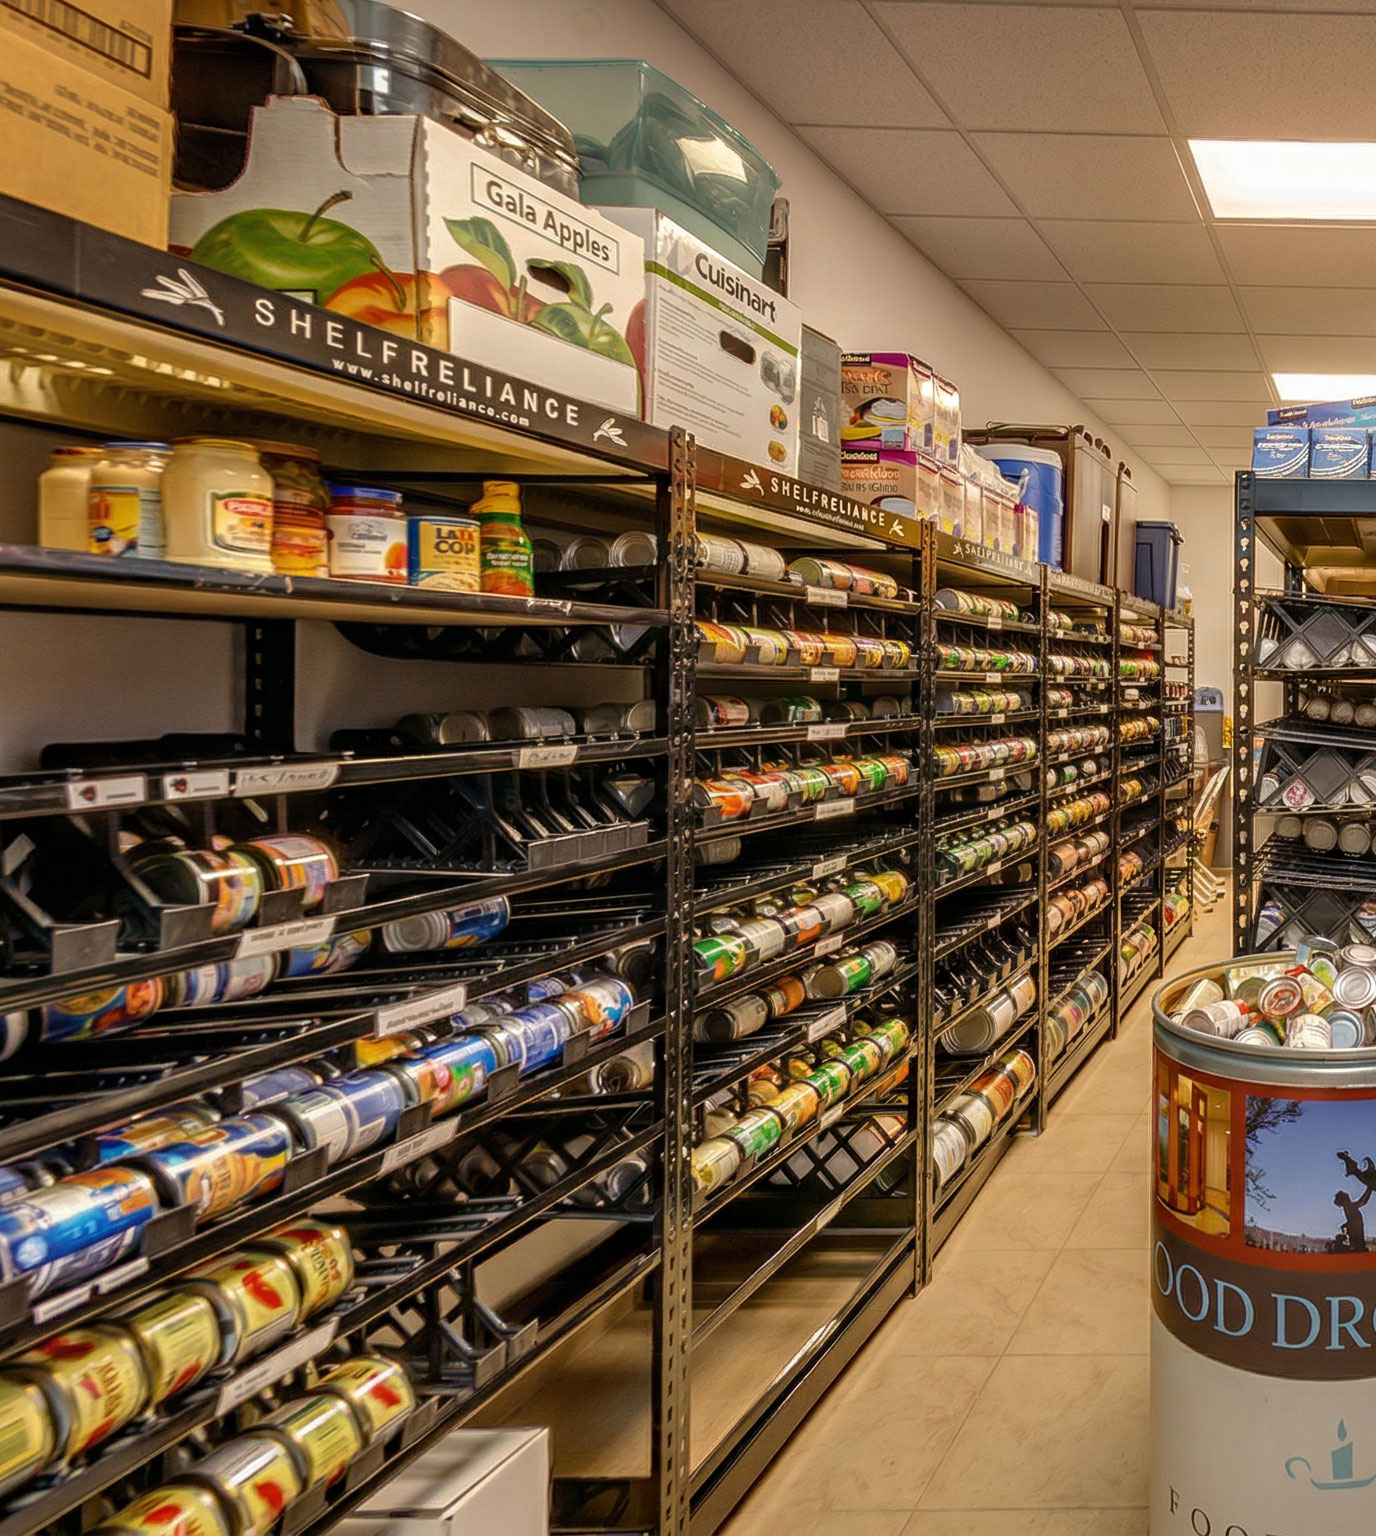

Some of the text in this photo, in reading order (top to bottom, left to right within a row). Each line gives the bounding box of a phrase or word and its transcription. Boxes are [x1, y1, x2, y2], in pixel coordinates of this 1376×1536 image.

[486, 180, 610, 262] Gala Apples
[695, 253, 776, 323] Cuisinart
[254, 298, 579, 426] SHELFRELIANCE
[770, 477, 886, 527] SHELFRELIANCE
